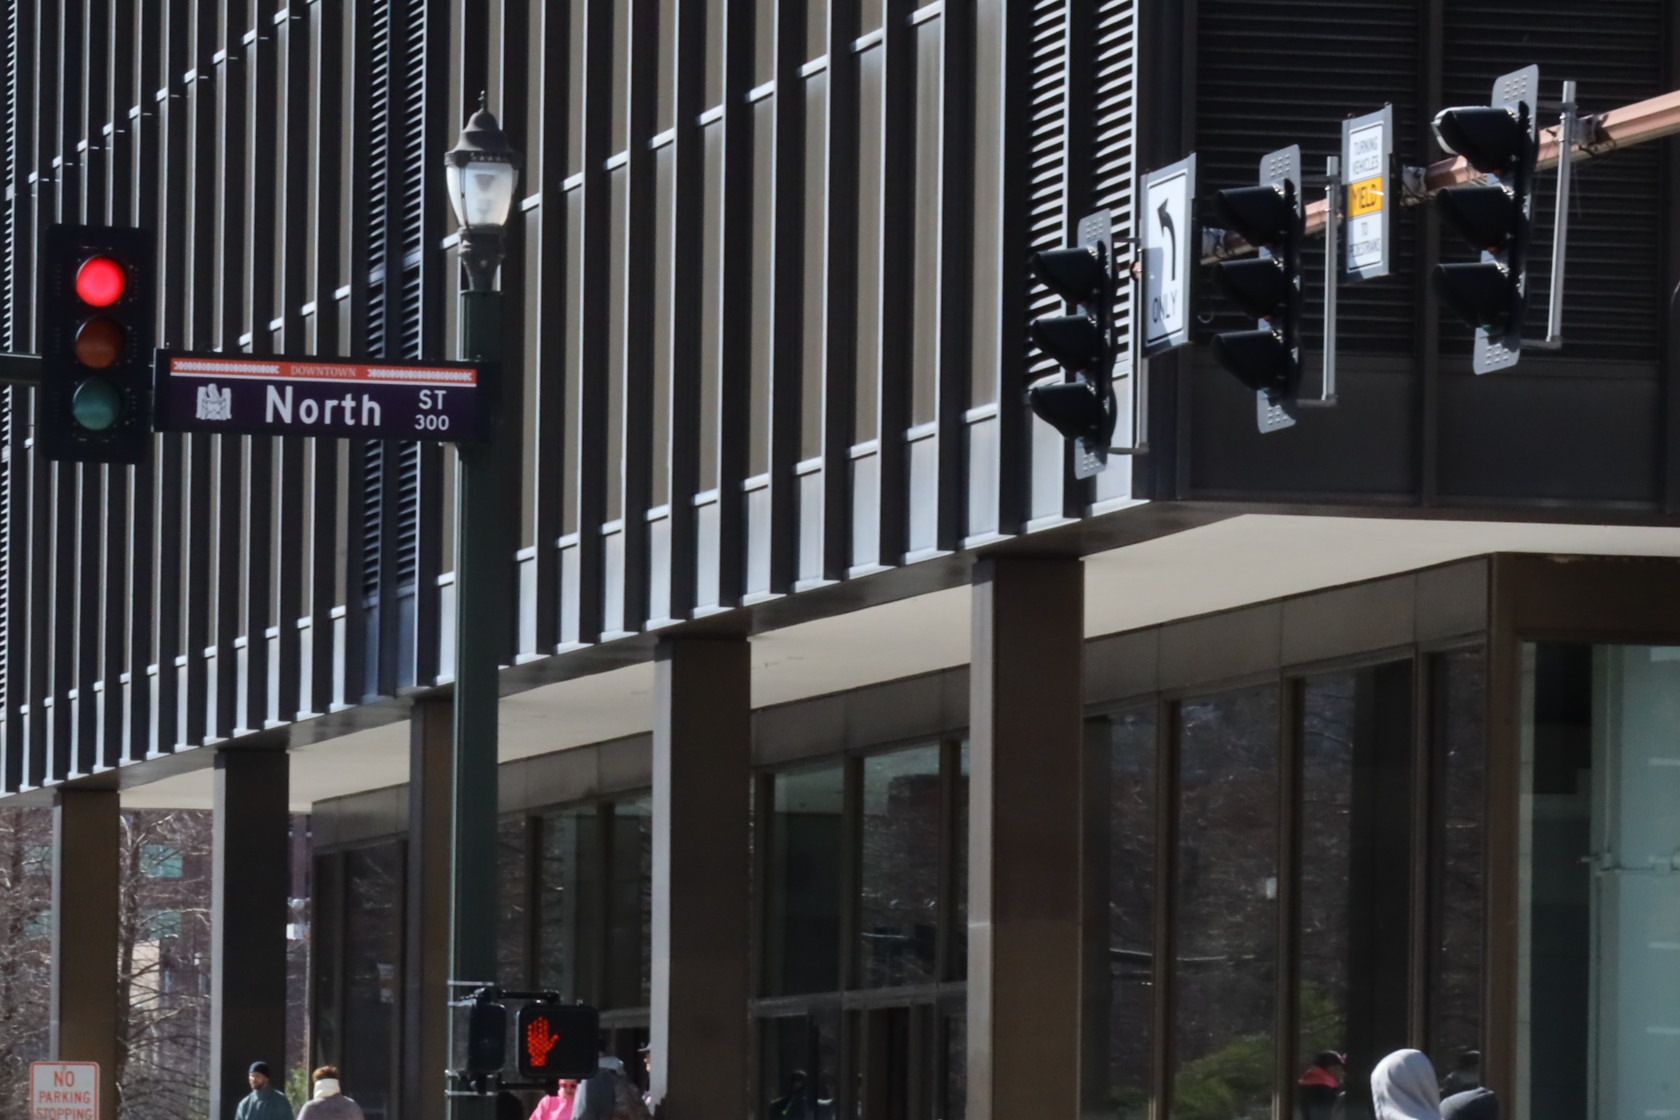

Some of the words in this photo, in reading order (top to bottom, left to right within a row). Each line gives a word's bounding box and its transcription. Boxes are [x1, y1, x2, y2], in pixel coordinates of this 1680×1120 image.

[1351, 184, 1377, 209] YIELD
[1152, 289, 1178, 323] ONLY
[289, 365, 357, 378] DOWNTOWN
[265, 384, 381, 426] North
[418, 389, 447, 411] ST
[414, 414, 450, 431] 300
[54, 1071, 75, 1088] NO
[39, 1091, 91, 1104] PARKING
[36, 1108, 93, 1120] STOPPING
